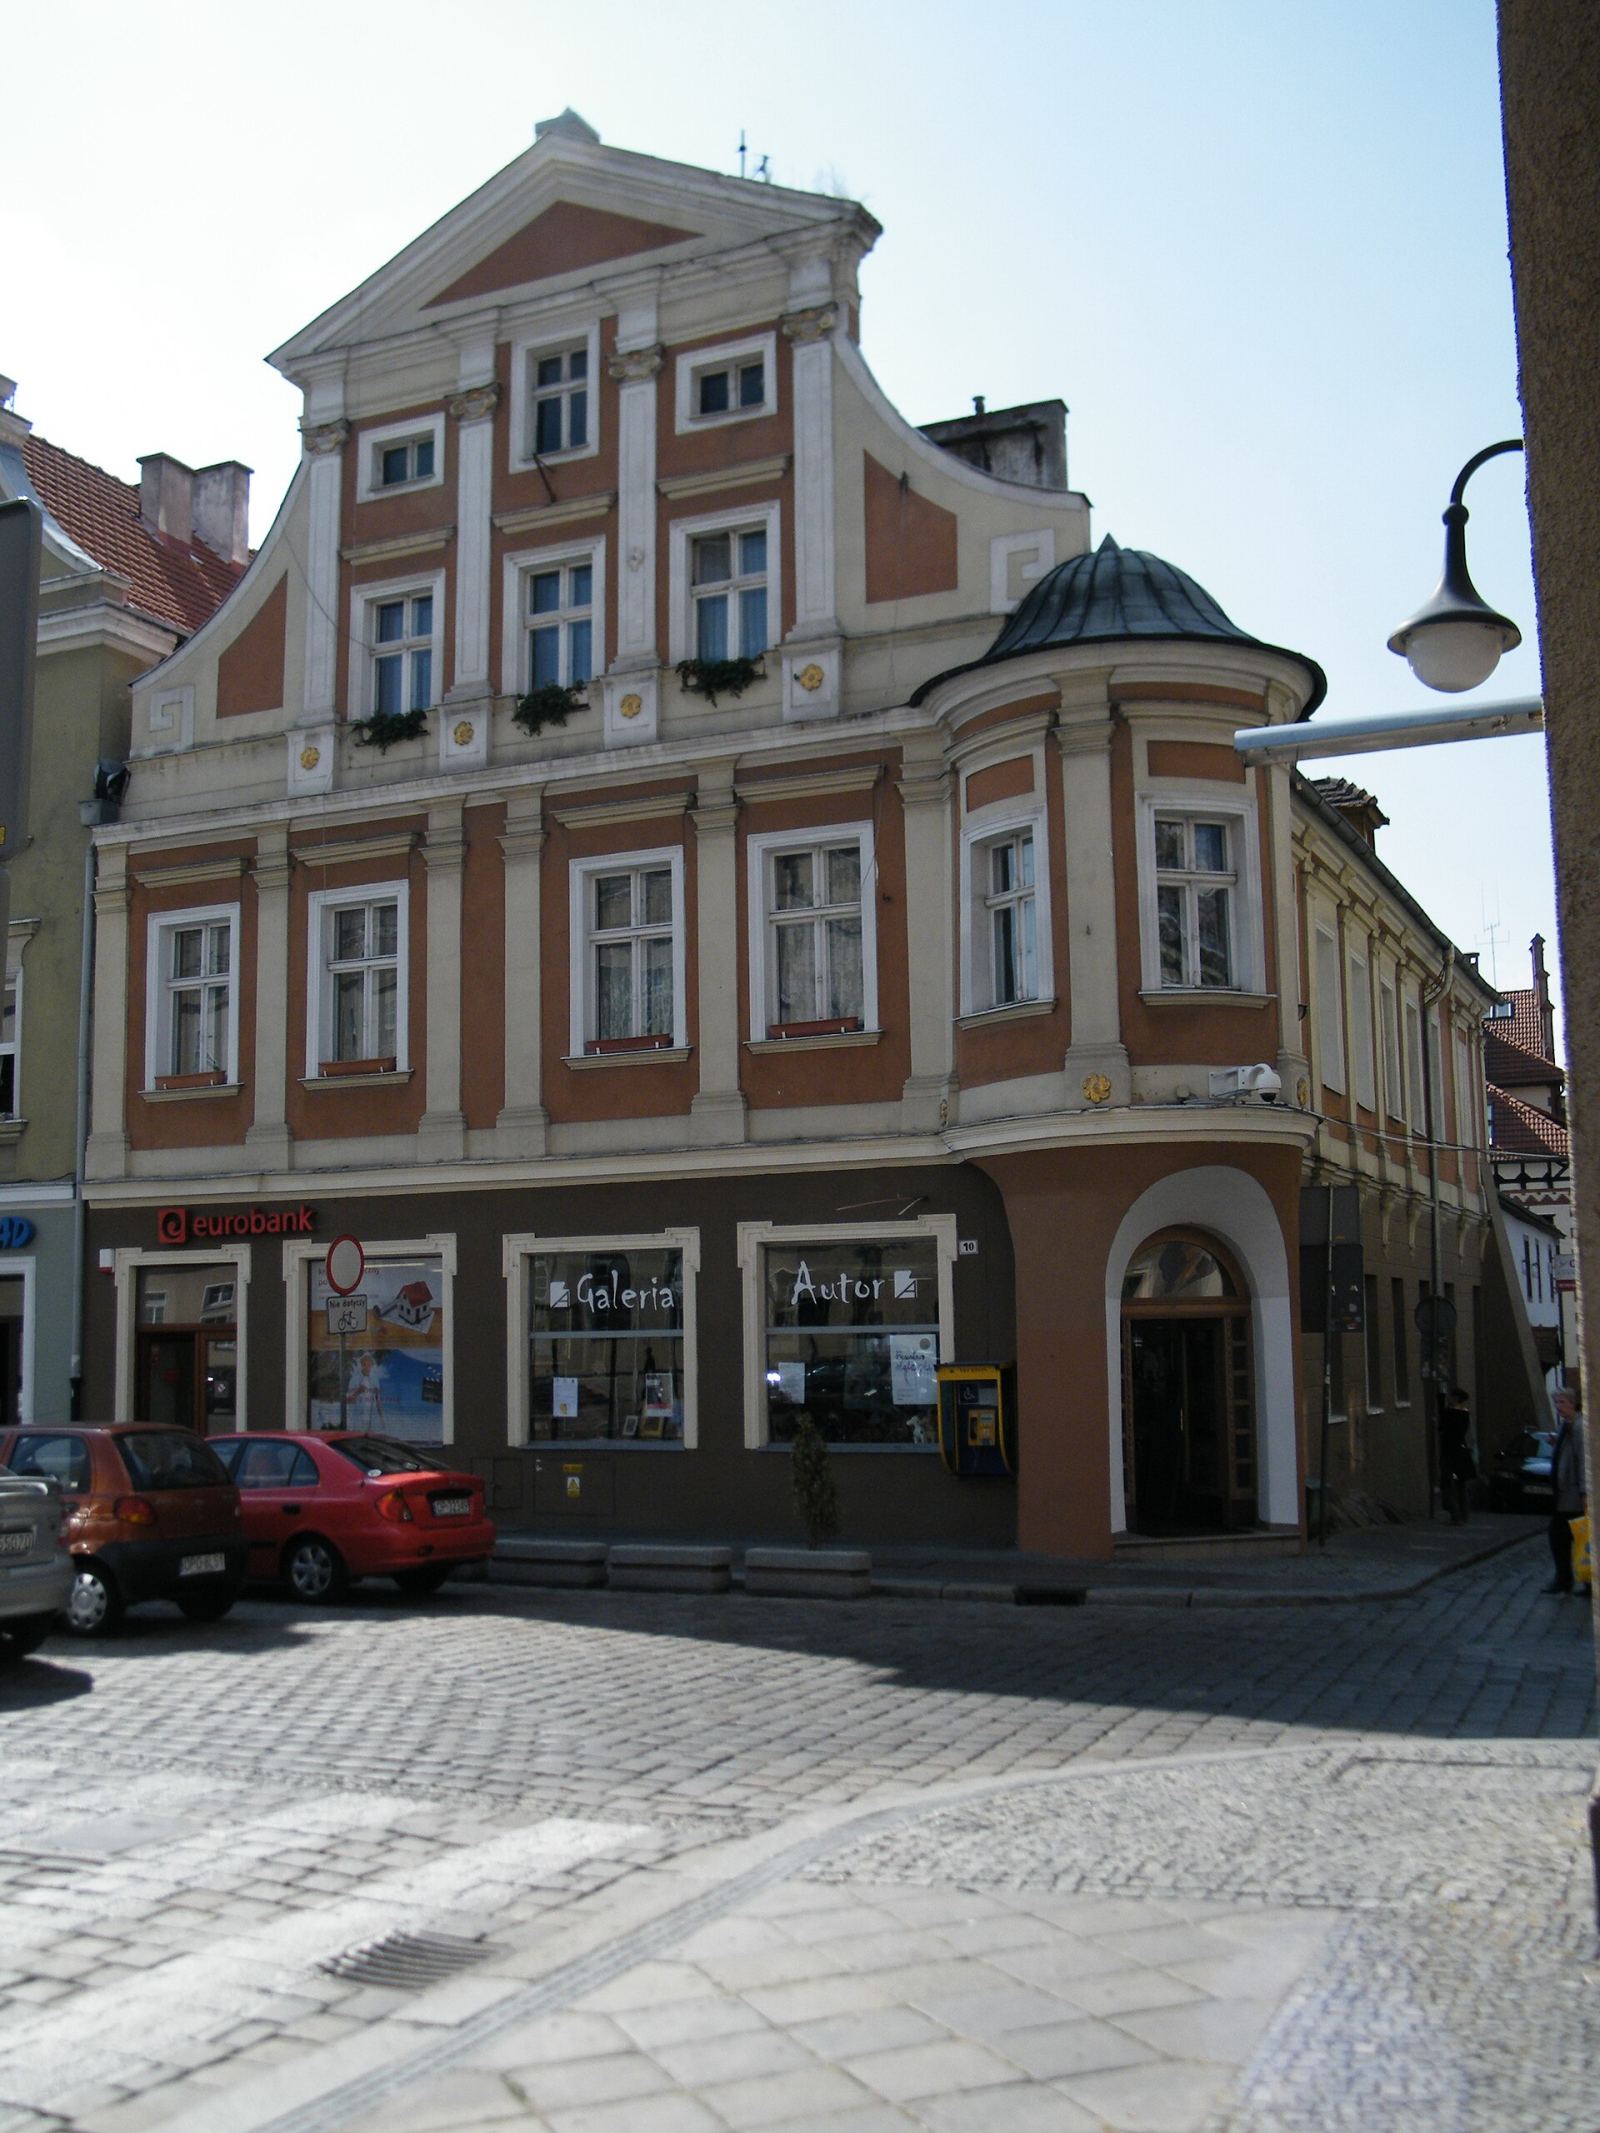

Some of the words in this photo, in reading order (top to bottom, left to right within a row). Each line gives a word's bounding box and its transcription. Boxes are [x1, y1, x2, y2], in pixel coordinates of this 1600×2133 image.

[193, 1204, 313, 1237] eurobank
[963, 1242, 975, 1251] 10
[577, 1269, 674, 1313] Galeria
[791, 1260, 885, 1305] Autor
